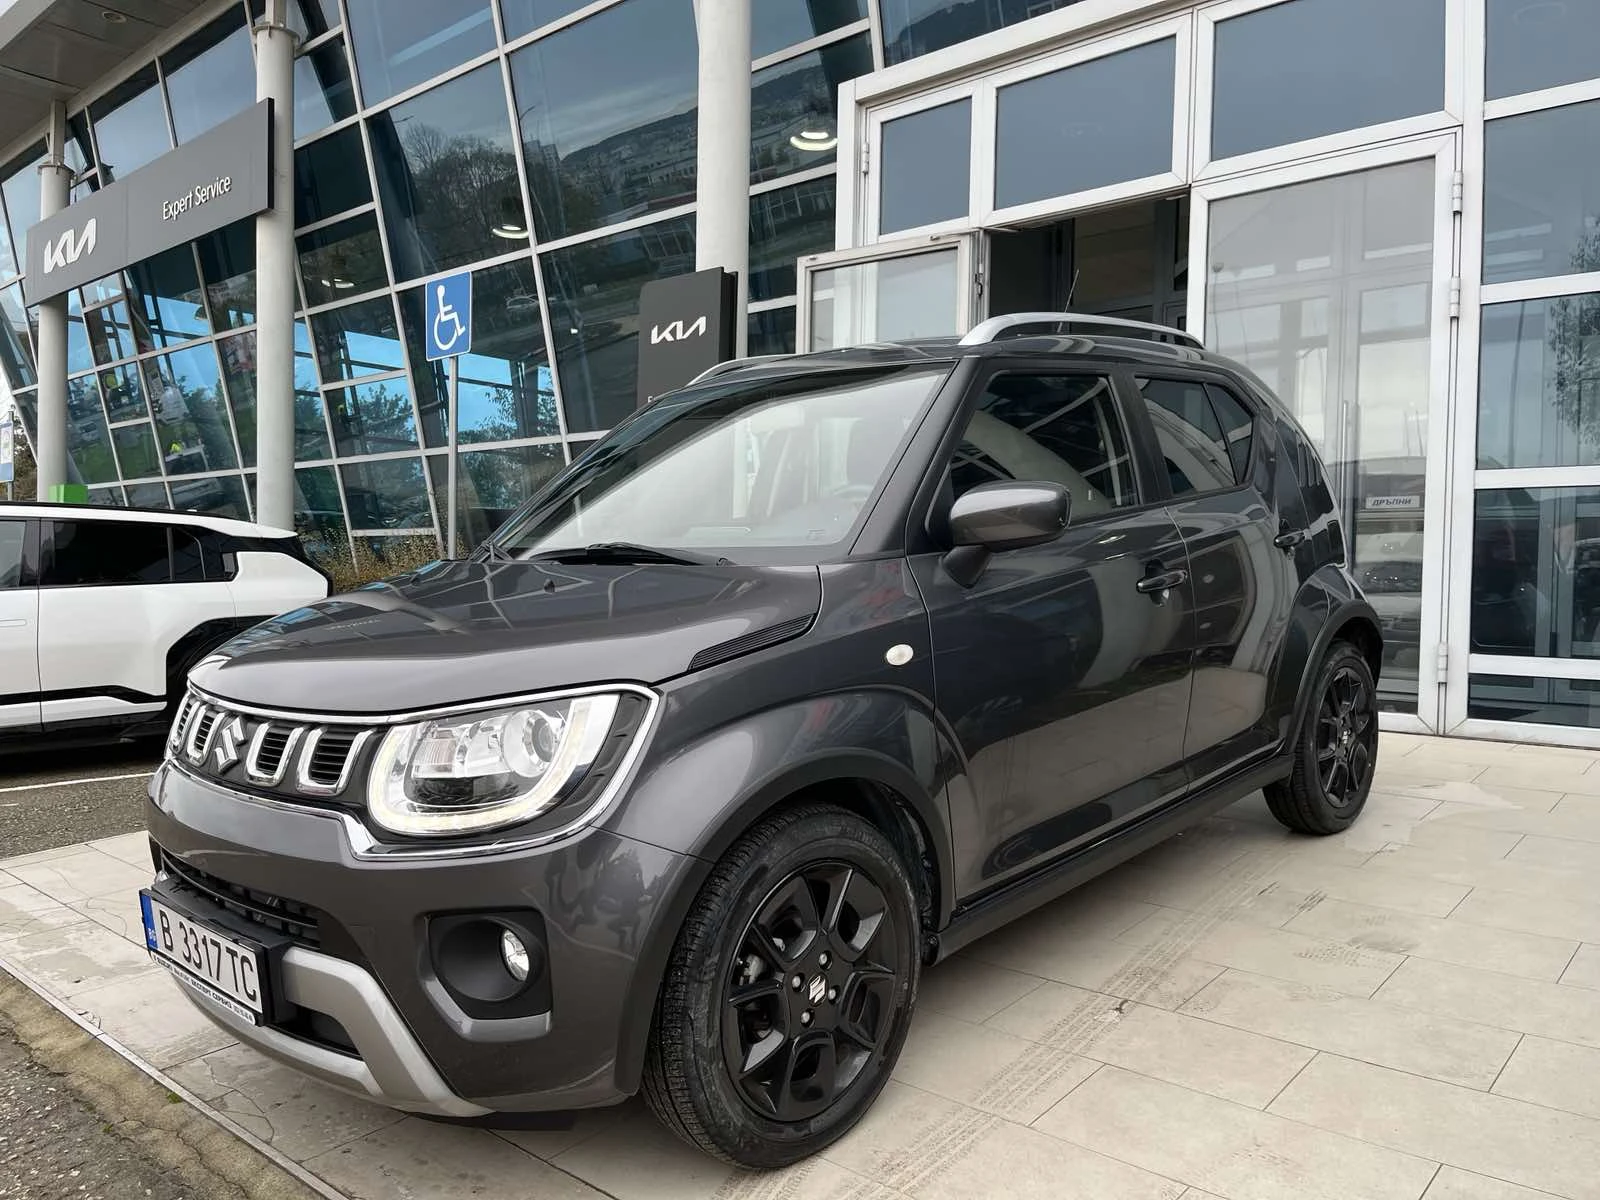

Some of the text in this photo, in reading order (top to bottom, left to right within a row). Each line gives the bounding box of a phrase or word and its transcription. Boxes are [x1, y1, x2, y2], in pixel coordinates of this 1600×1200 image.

[163, 176, 231, 221] Expert Service
[44, 218, 97, 274] KIA
[651, 316, 707, 345] KIA
[1372, 497, 1412, 506] ДРЪПНИ
[159, 909, 257, 1002] B 3317 TC
